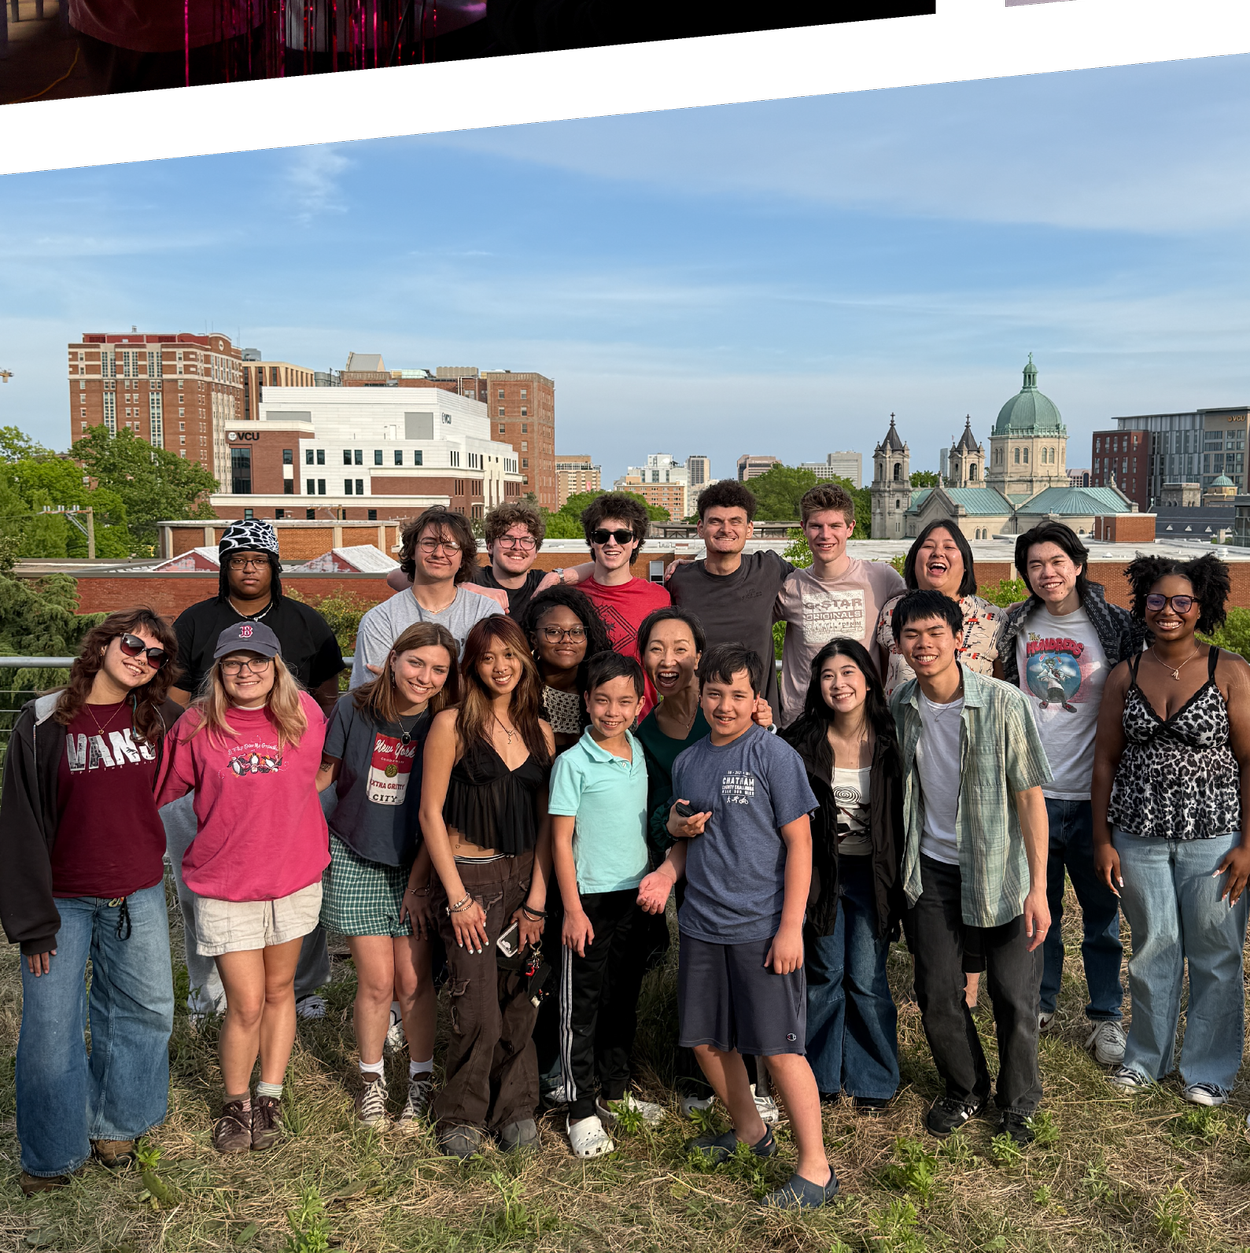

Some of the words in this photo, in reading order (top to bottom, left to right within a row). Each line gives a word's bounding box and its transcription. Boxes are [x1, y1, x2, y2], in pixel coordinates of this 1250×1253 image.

[237, 432, 260, 441] VCU
[239, 625, 254, 638] B
[1026, 637, 1084, 659] HUNDREDS
[374, 739, 394, 754] New
[394, 742, 416, 760] York
[722, 777, 755, 787] CHATHAM
[372, 793, 398, 803] CITY
